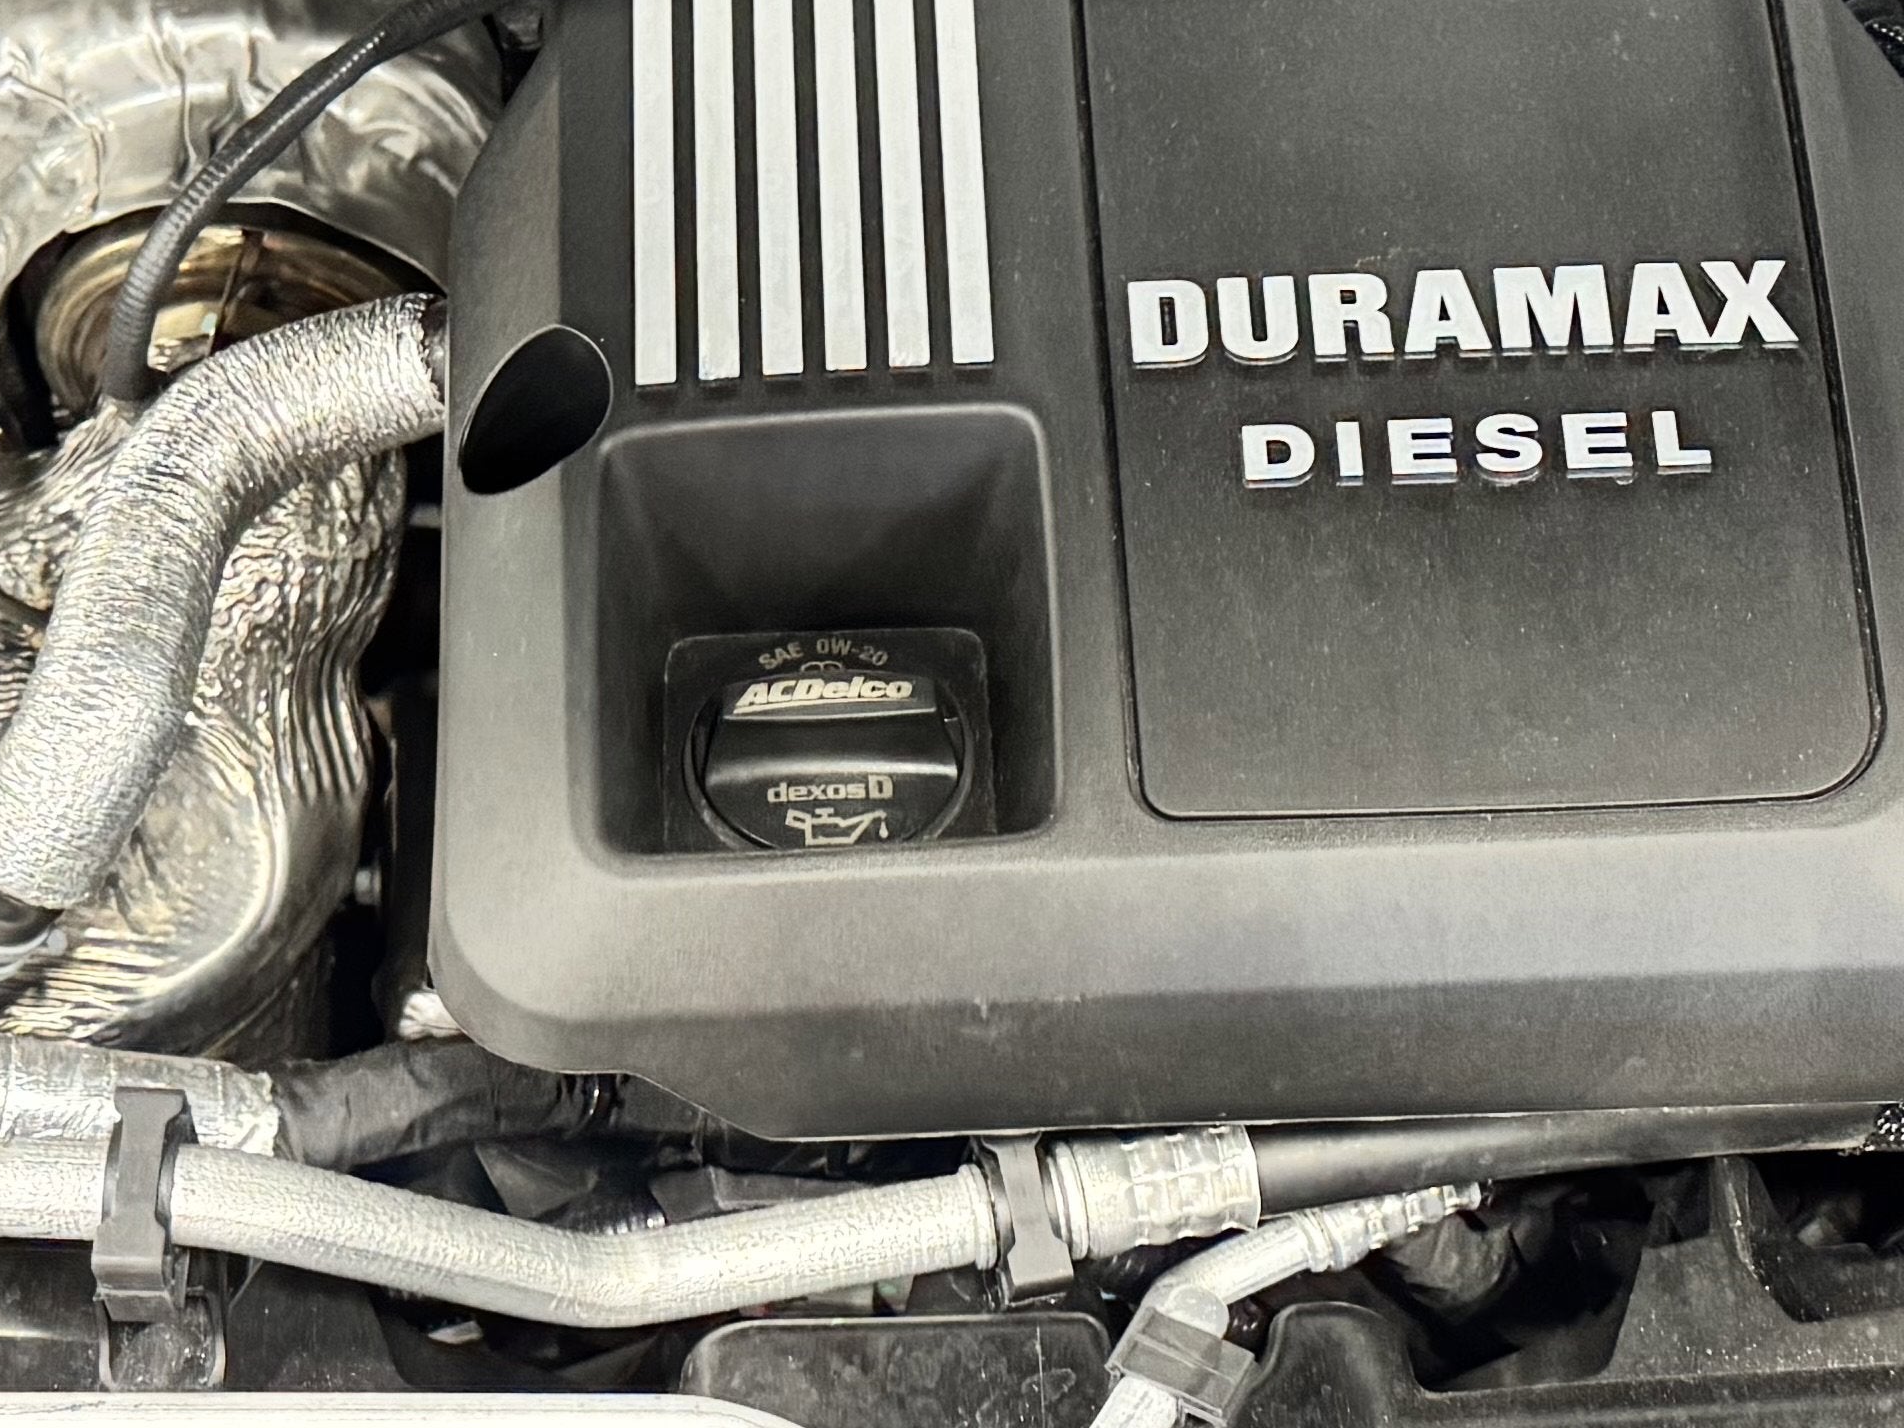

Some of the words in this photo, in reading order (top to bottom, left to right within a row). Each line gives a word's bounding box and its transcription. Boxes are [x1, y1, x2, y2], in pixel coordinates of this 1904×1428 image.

[1126, 258, 1798, 367] DURAMAX
[1240, 410, 1712, 487] DIESEL
[758, 640, 805, 670] SAE
[816, 637, 889, 667] 0W-20
[734, 676, 914, 708] ACDelco
